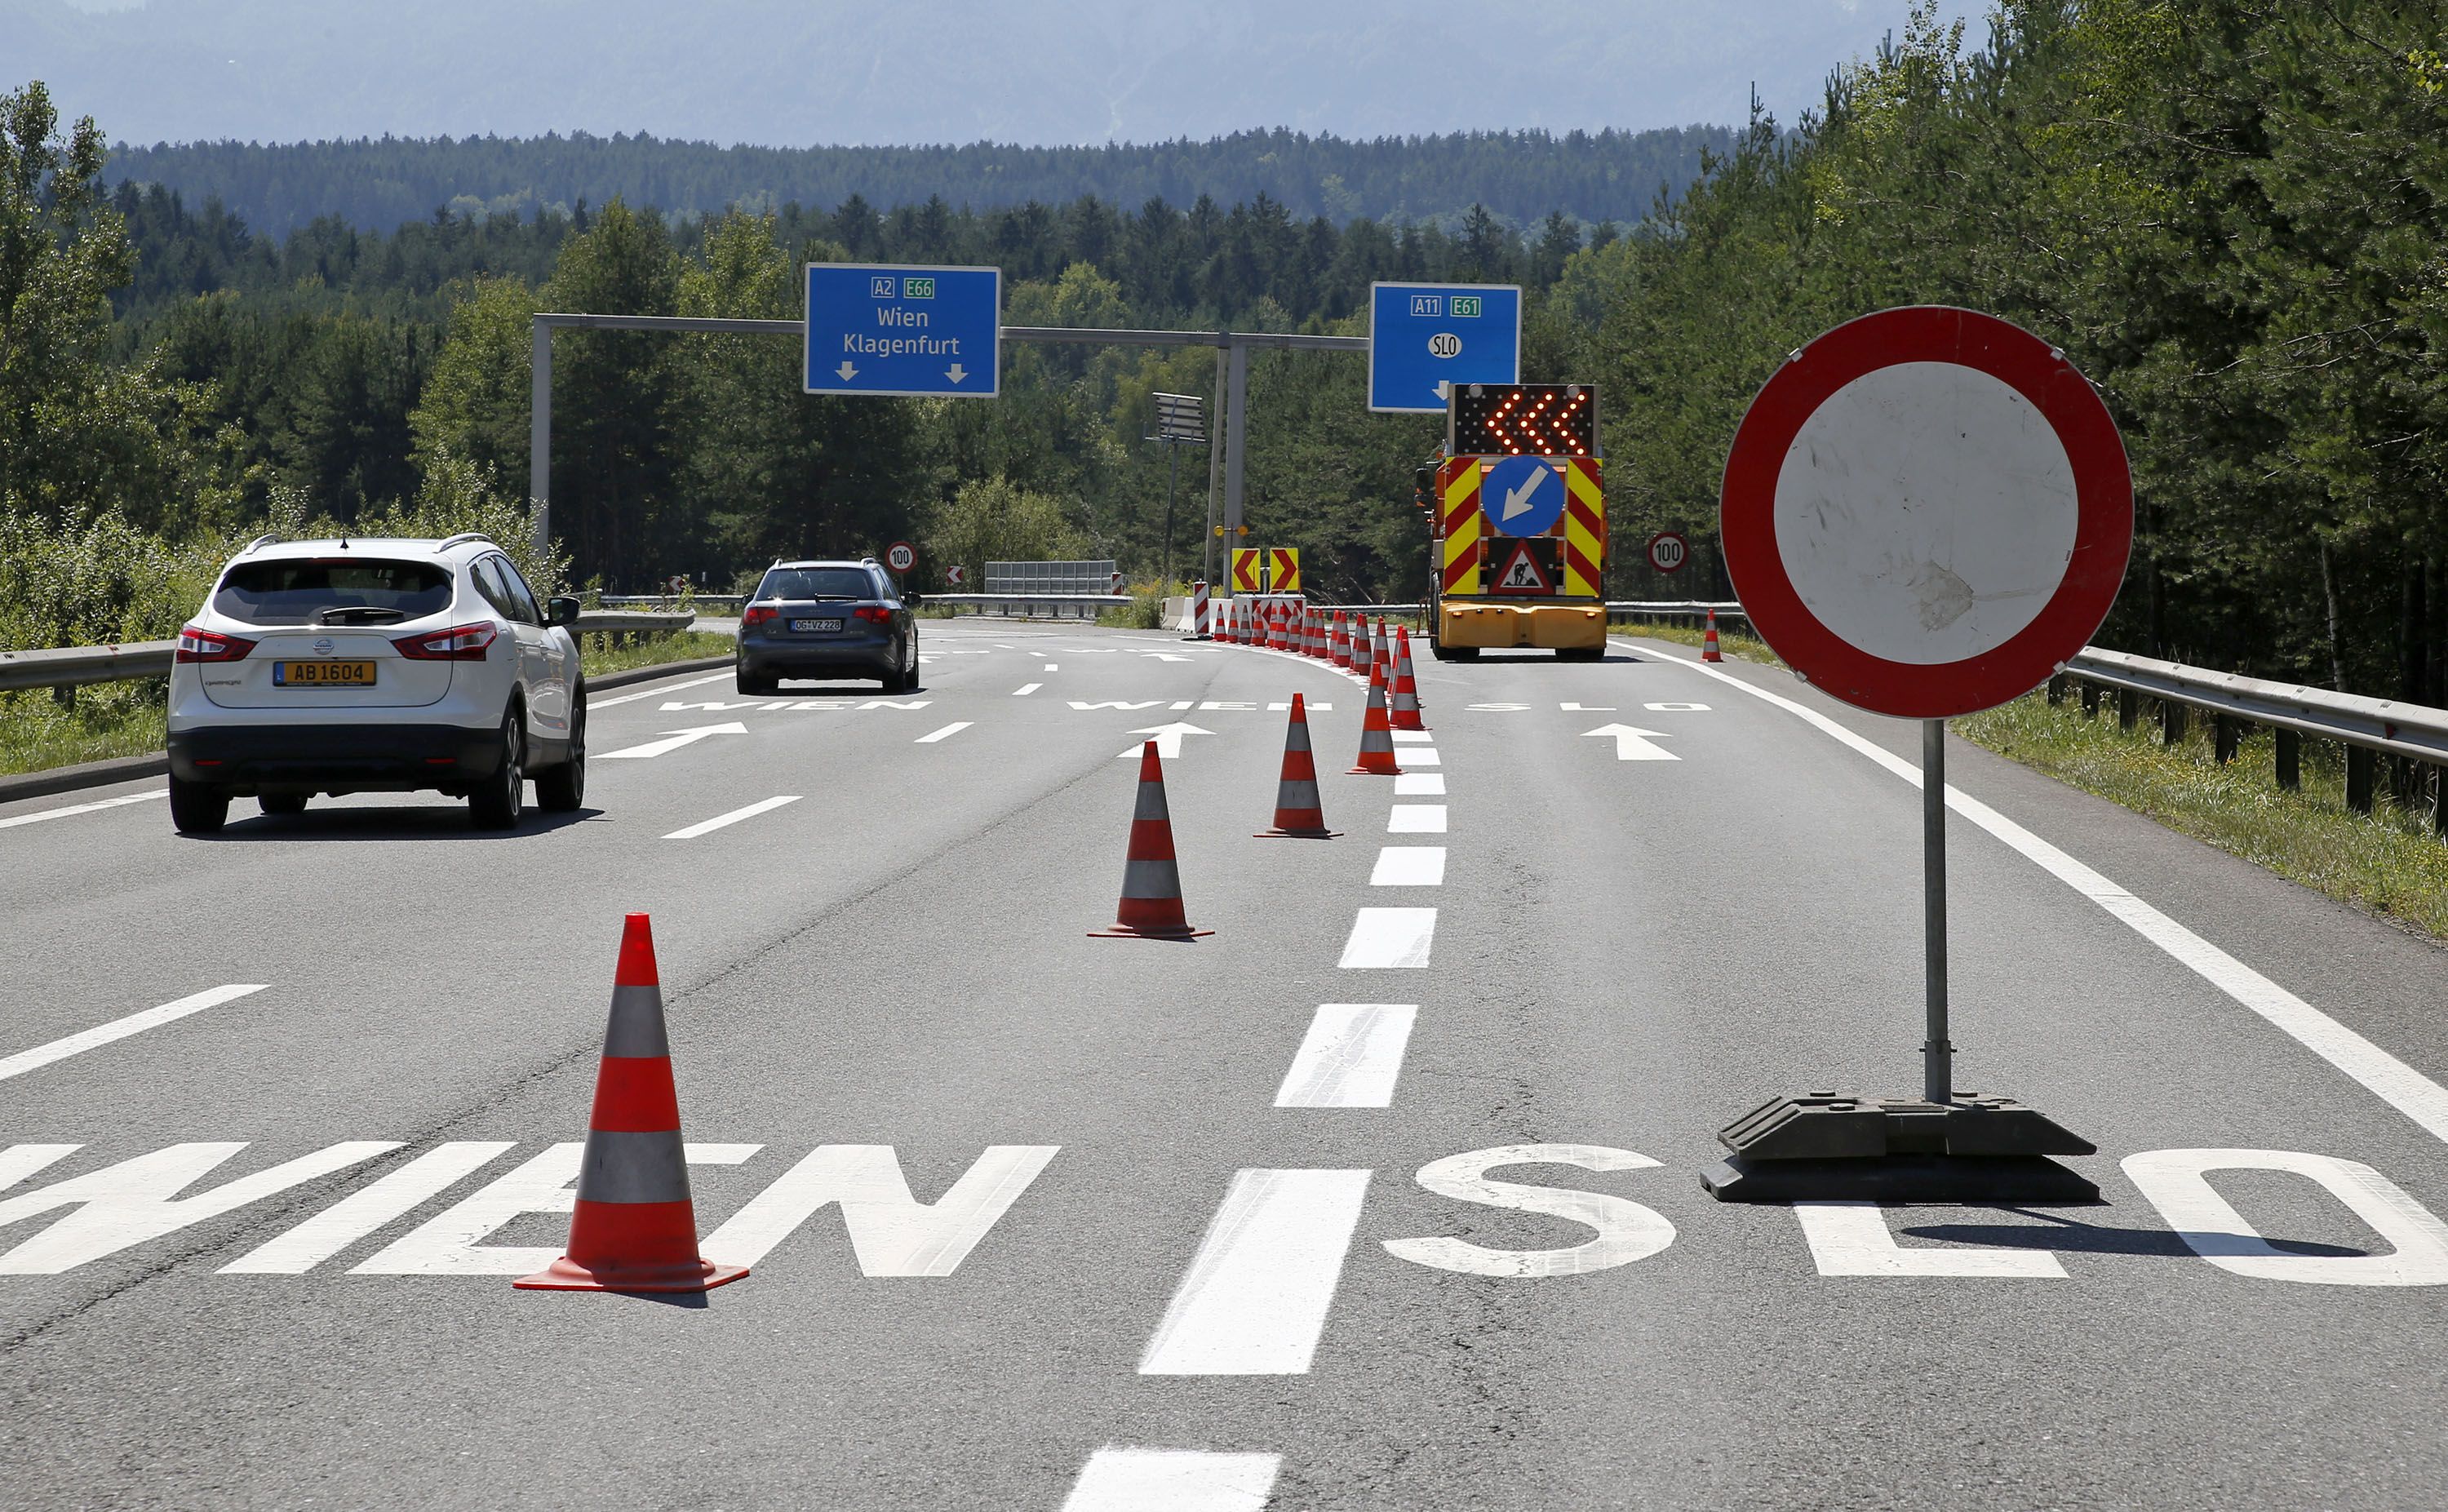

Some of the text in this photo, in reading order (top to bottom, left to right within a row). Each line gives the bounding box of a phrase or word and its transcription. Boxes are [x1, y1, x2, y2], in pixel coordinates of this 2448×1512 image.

[874, 280, 932, 296] A2 E66
[1414, 298, 1478, 315] A11 E61
[876, 306, 929, 327] Wien
[843, 333, 960, 357] Klagenfurt
[1433, 335, 1457, 356] SLO
[892, 550, 909, 565] 100
[1656, 543, 1680, 561] 100
[796, 620, 840, 629] OG VZ 228
[294, 664, 317, 681] AB
[321, 664, 364, 681] 1604
[658, 701, 934, 712] WIEN
[1066, 701, 1333, 712] WIEN
